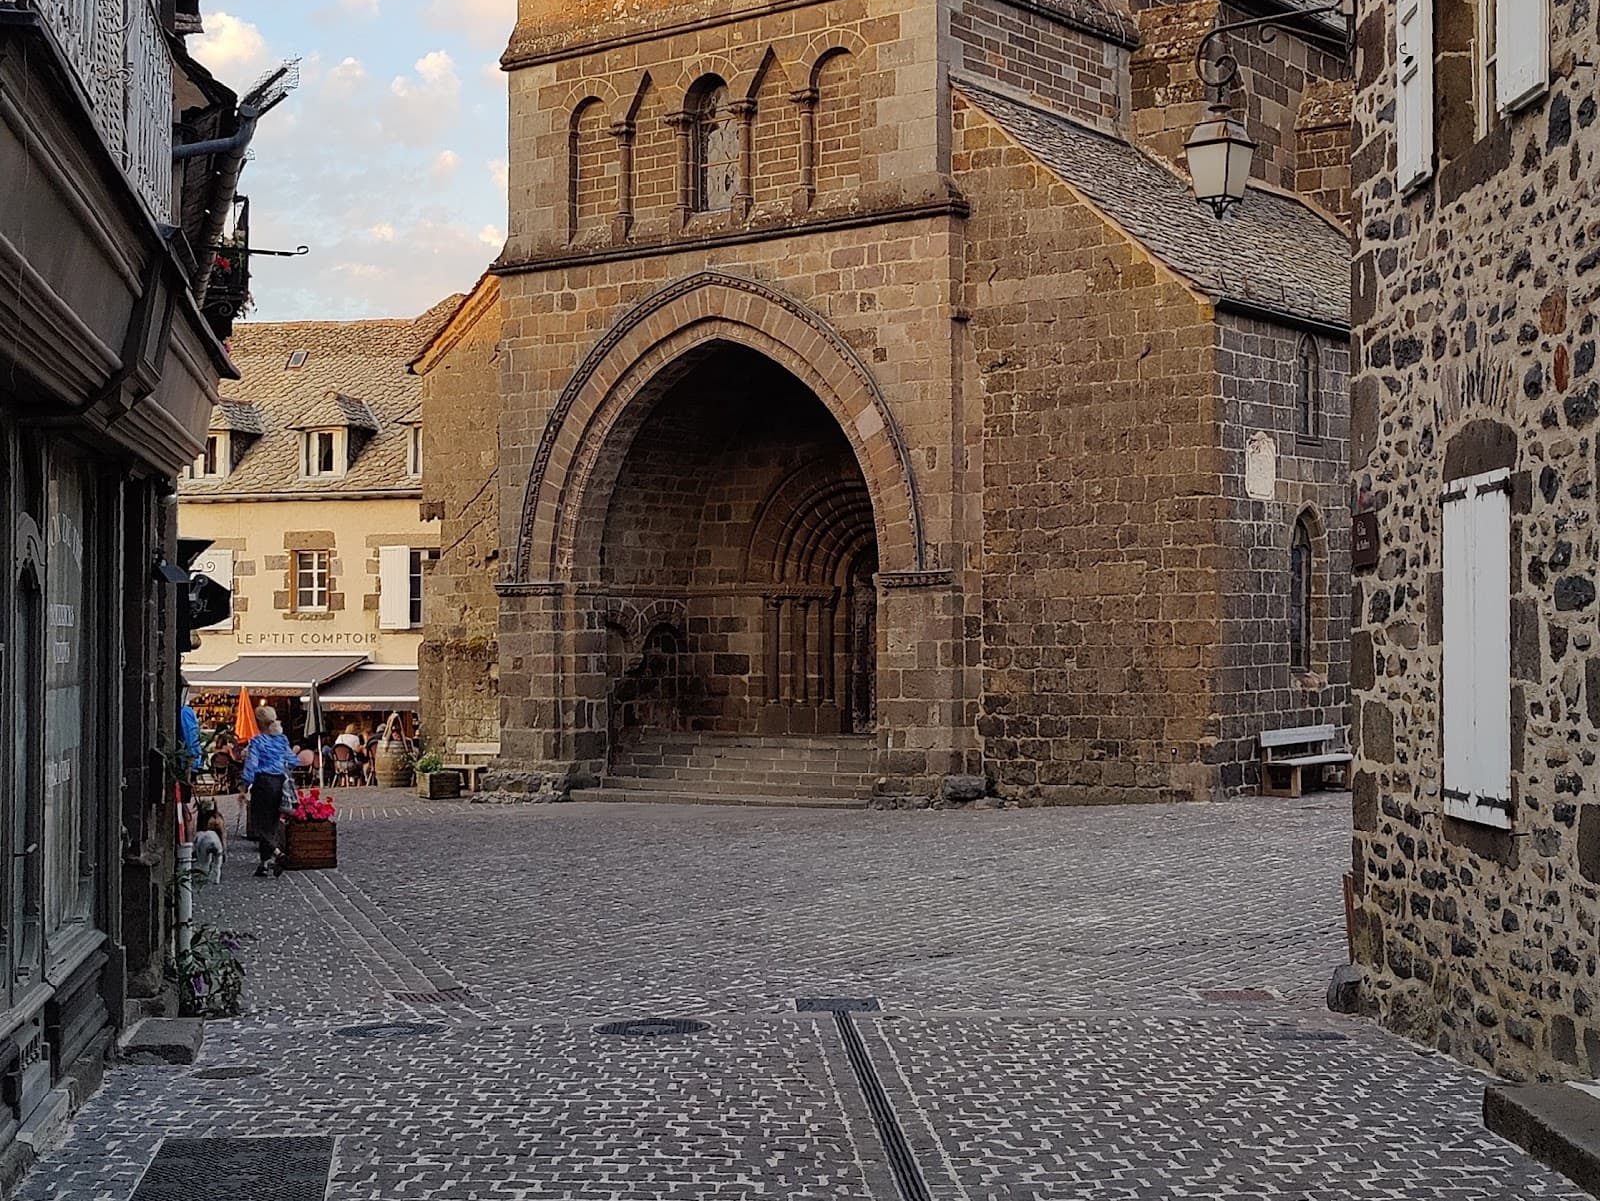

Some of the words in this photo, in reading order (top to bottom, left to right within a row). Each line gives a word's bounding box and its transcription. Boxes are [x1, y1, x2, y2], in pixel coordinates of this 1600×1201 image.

[237, 633, 253, 644] LE
[260, 633, 295, 644] P'TIT
[301, 633, 377, 644] COMPTOIR
